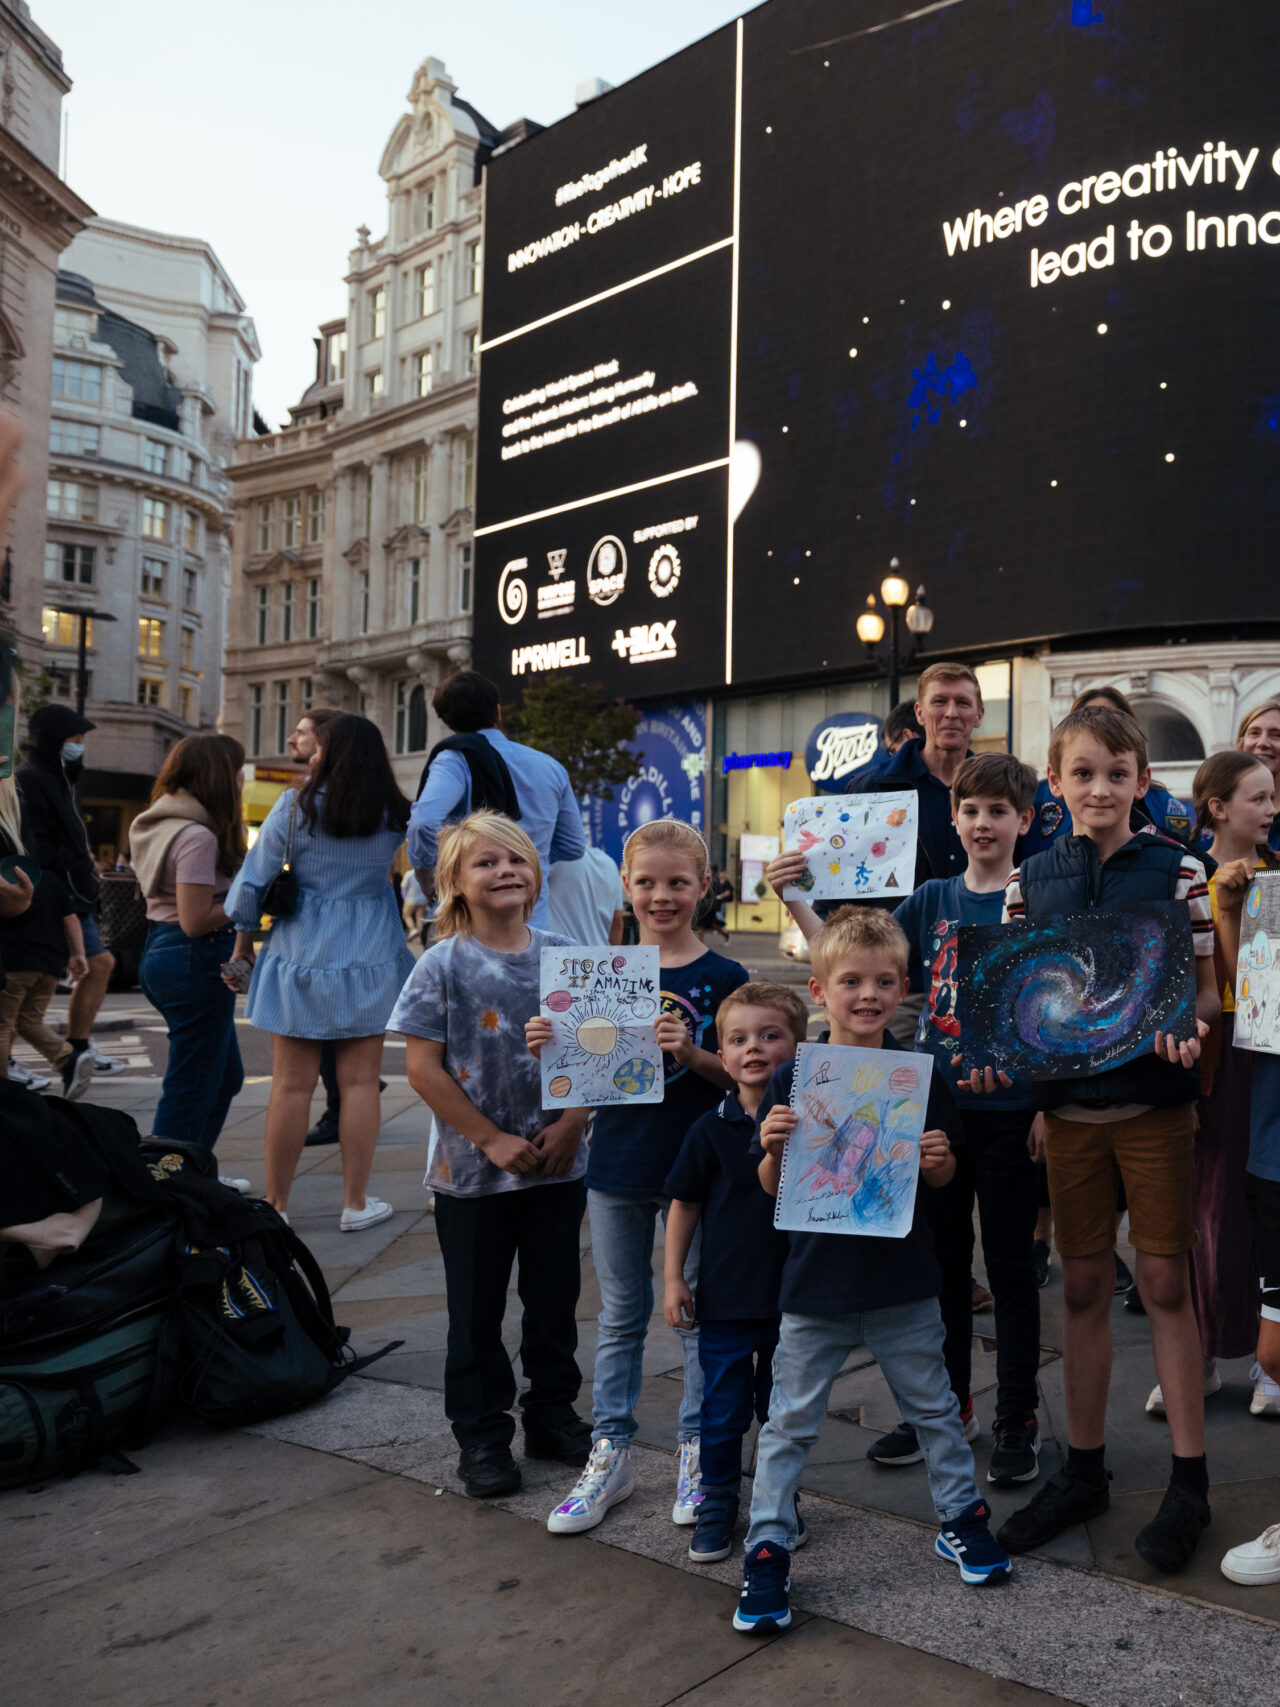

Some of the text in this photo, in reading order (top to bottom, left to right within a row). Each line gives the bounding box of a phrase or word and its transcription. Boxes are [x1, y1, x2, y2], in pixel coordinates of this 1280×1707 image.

[507, 221, 580, 273] INNOVATION
[586, 184, 655, 234] CREATIVITY
[662, 161, 702, 198] HOPE
[942, 194, 1050, 256] Where
[1057, 140, 1260, 215] creativity
[1030, 224, 1115, 288] lead
[1126, 219, 1172, 260] to
[633, 515, 699, 544] SUPPORTED BY
[680, 715, 703, 748] AND
[810, 722, 878, 782] Boots
[722, 751, 792, 774] pharmacy
[594, 976, 656, 994] AMAZING
